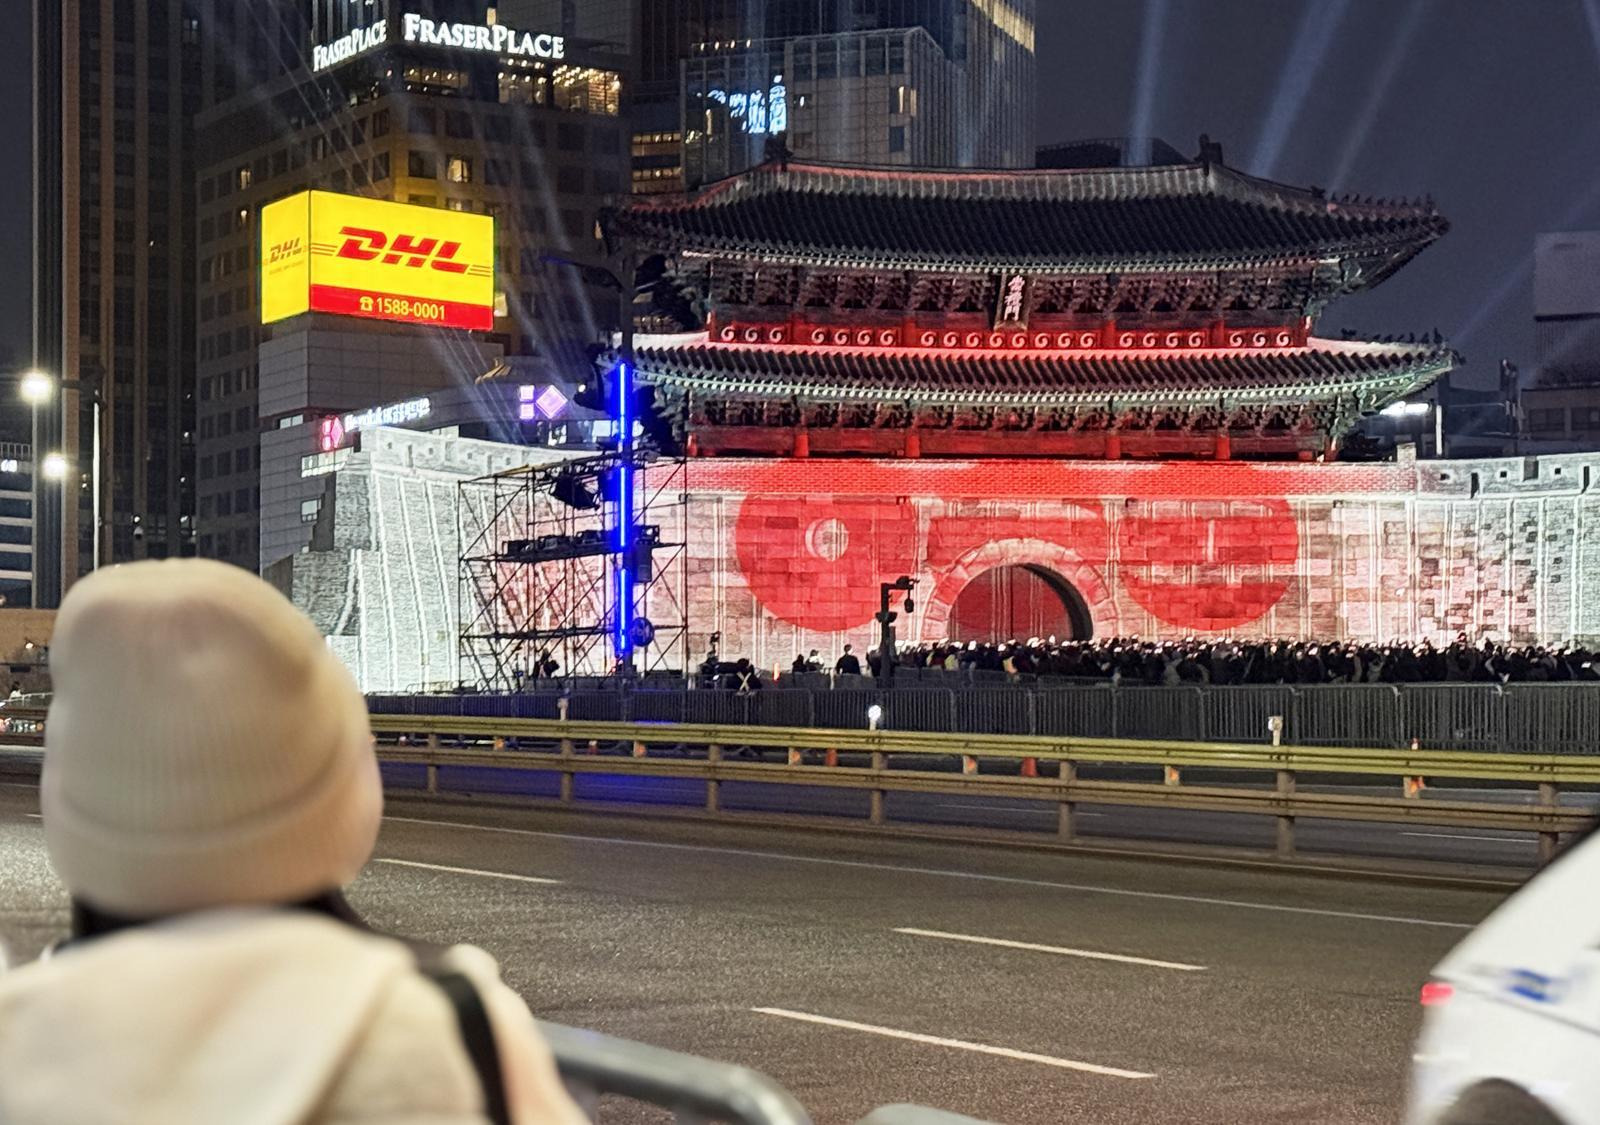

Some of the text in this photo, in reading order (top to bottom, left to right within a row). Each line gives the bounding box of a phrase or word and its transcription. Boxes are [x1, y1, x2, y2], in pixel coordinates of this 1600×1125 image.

[269, 237, 303, 263] DHL
[336, 226, 470, 274] DHL
[376, 297, 446, 321] 1588-0001
